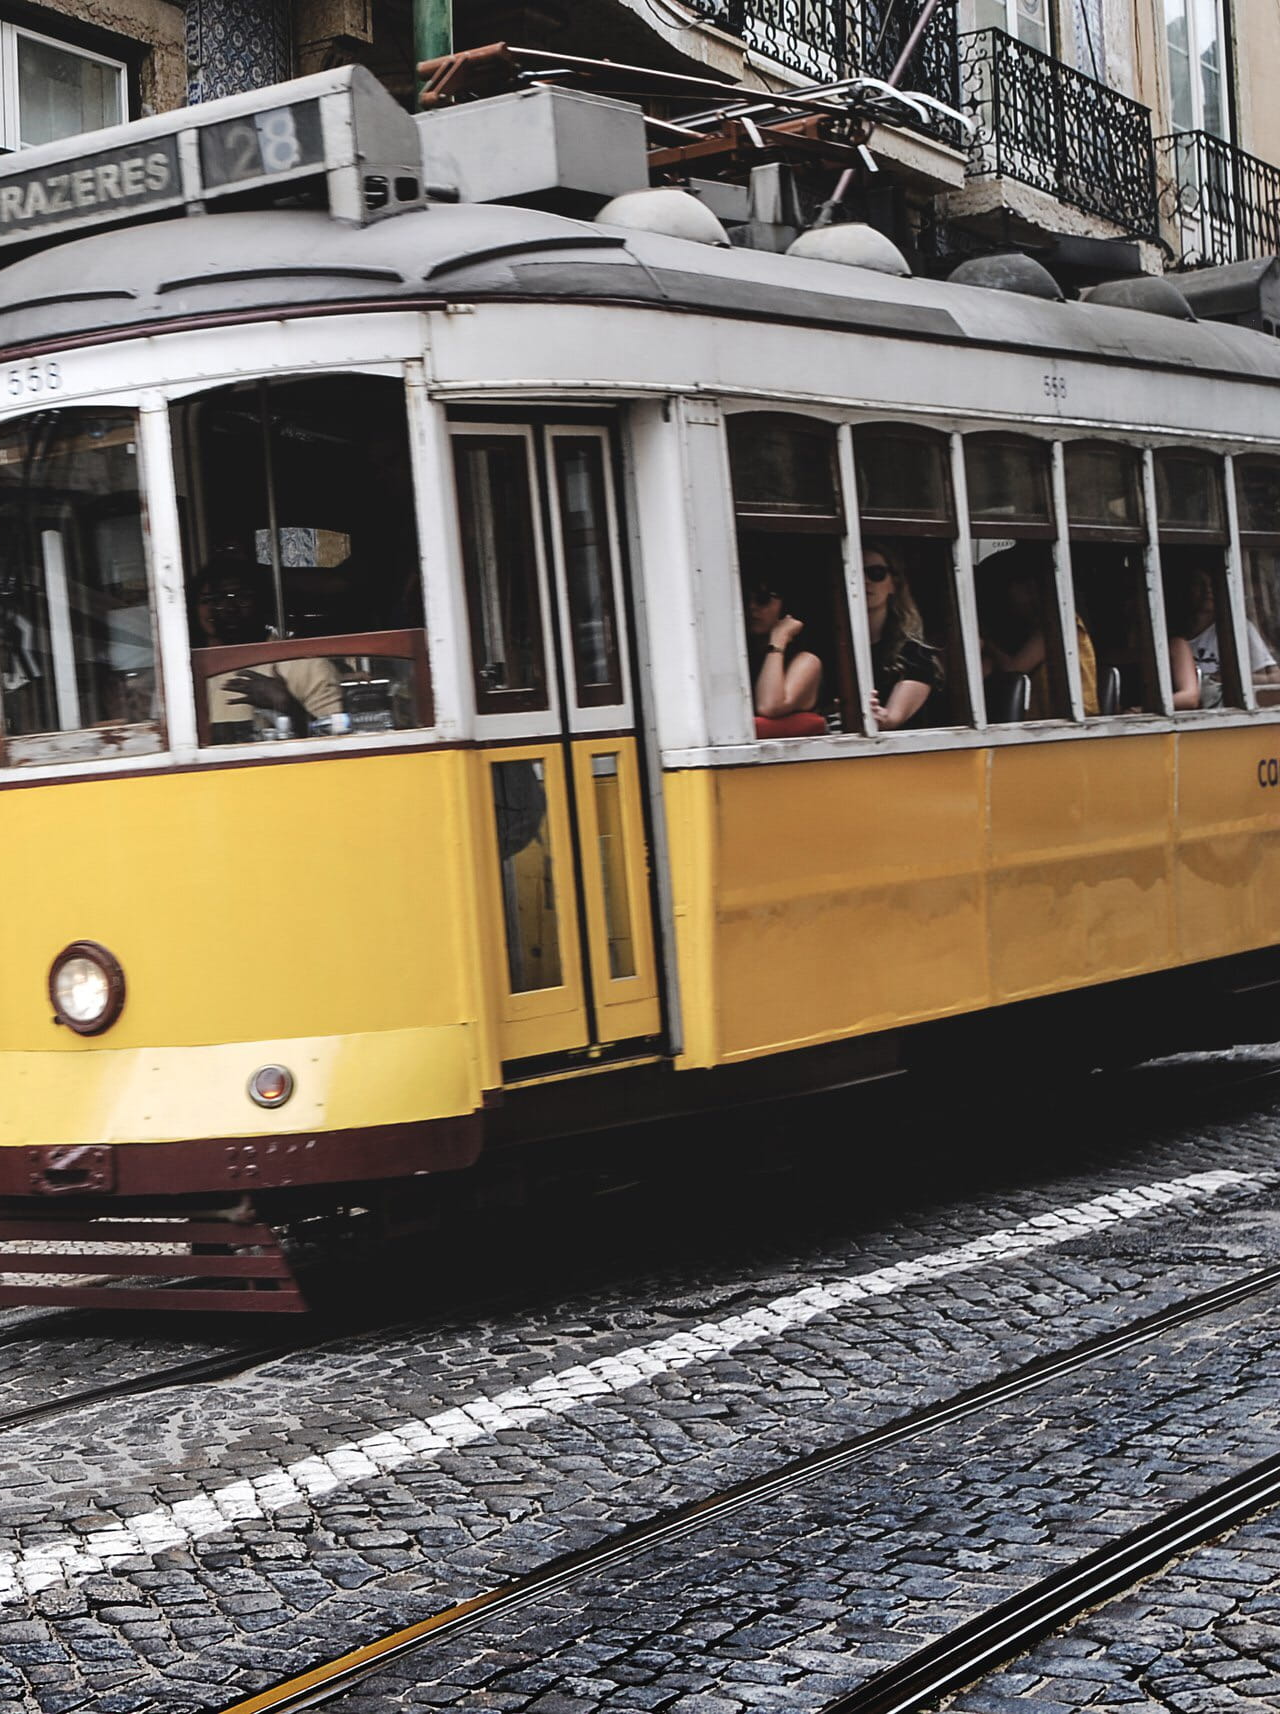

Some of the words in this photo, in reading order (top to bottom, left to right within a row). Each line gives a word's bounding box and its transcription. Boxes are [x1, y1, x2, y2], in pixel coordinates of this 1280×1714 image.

[224, 105, 301, 179] 28
[8, 362, 62, 395] 558
[1044, 375, 1067, 399] 558
